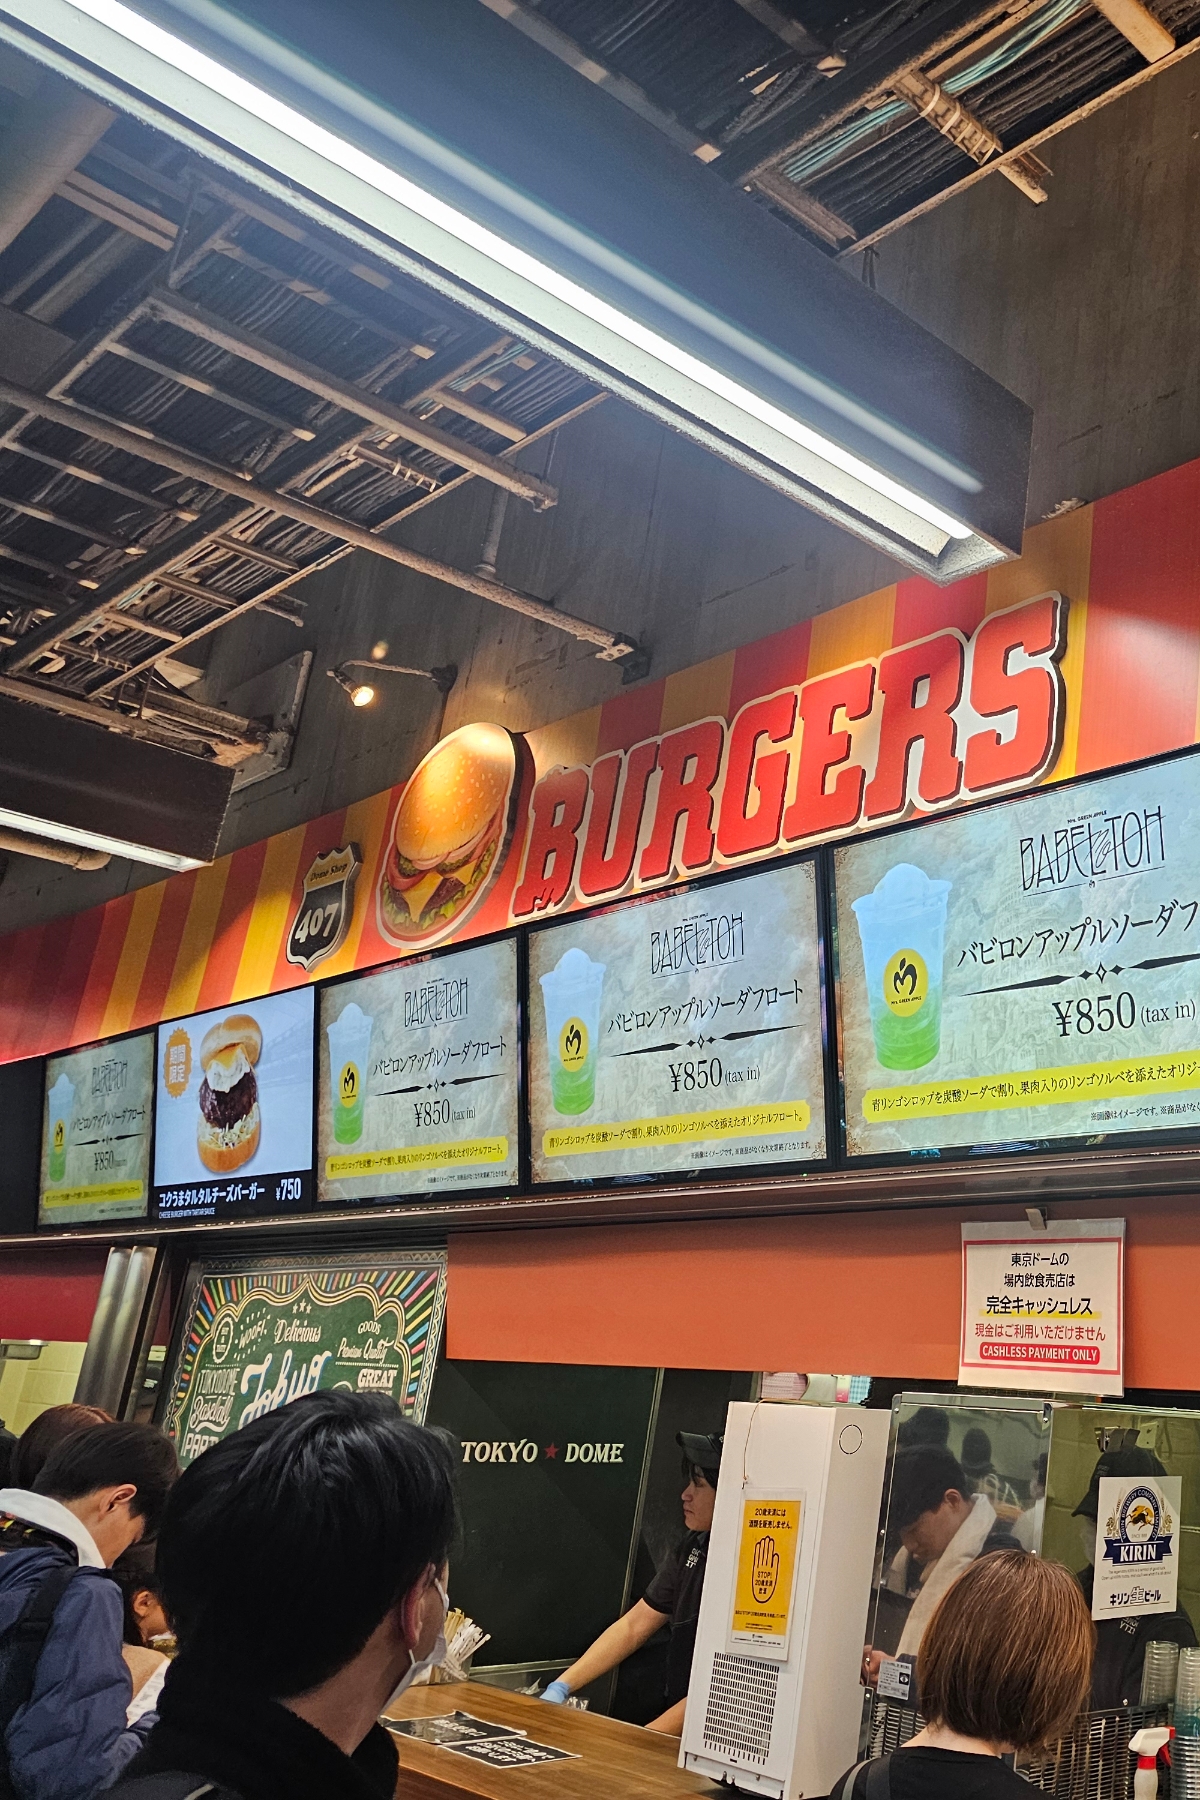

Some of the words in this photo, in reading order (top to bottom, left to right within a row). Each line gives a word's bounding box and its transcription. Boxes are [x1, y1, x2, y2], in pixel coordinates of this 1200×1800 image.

[514, 596, 1061, 916] BURGERS
[310, 869, 329, 882] Dome
[330, 863, 348, 876] Shop
[294, 902, 339, 944] 407
[607, 979, 804, 1034] バビロンアップルソーダフロート
[1052, 991, 1136, 1038] ¥850
[1141, 1008, 1170, 1028] (tax
[1174, 999, 1196, 1020] in)
[372, 1035, 507, 1076] バビロンアップルソーダフロート
[668, 1058, 723, 1092] ¥850
[725, 1068, 743, 1086] (tax
[746, 1064, 760, 1081] in)
[414, 1099, 450, 1127] ¥850
[451, 1110, 465, 1123] (tax
[466, 1107, 476, 1120] in)
[158, 1181, 265, 1208] コクうまタルタルチーズバーガー
[275, 1177, 301, 1201] ¥750
[1011, 1252, 1069, 1267] 東京ドームの
[1004, 1273, 1076, 1288] 場内飲食売店は
[986, 1295, 1093, 1315] 完全キャッシュレス
[274, 1319, 322, 1344] Delicious
[358, 1321, 381, 1335] GOODS
[975, 1323, 1106, 1341] 現金はご利用いただけません
[982, 1345, 1027, 1358] CASHLESS
[1028, 1347, 1070, 1360] PAYMENT
[1072, 1349, 1098, 1361] ONLY
[358, 1368, 397, 1388] GREAT
[460, 1438, 538, 1463] TOKYO
[564, 1442, 624, 1464] DOME
[1120, 1544, 1156, 1562] KIRIN
[757, 1571, 772, 1579] STOP!
[1110, 1586, 1161, 1606] キリン生ビール
